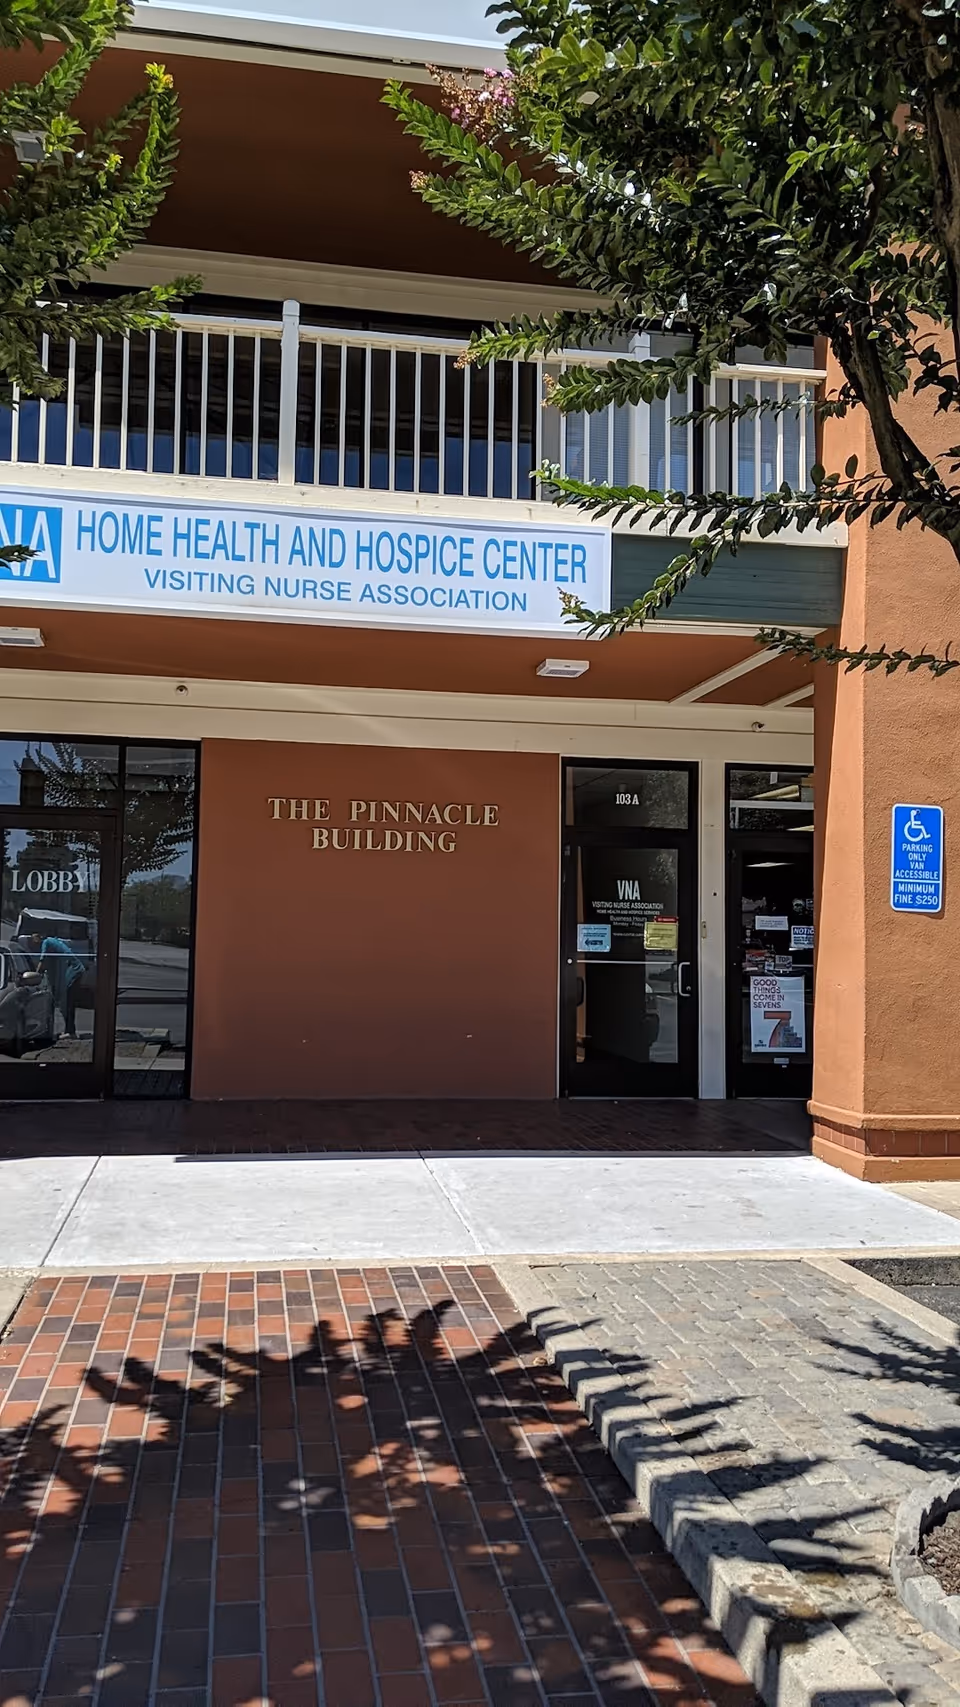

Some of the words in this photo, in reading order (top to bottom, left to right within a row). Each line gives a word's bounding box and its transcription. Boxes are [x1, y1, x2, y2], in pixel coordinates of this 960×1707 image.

[77, 510, 163, 556] HOME
[173, 517, 280, 564] HEALTH
[288, 525, 346, 569] AND
[355, 529, 475, 577] HOSPICE
[482, 538, 587, 583] CENTER
[144, 568, 255, 595] VISITING
[264, 576, 351, 601] NURSE
[359, 583, 527, 612] ASSOCIATION
[268, 798, 331, 821] THE
[349, 800, 500, 826] PINNACLE
[312, 827, 457, 853] BUILDING
[902, 843, 933, 853] PARKING
[908, 852, 926, 861] ONLY
[910, 861, 924, 870] VAN
[11, 870, 90, 893] LOBBY
[895, 870, 938, 880] ACCESSIBLE
[617, 880, 640, 900] VNA
[898, 883, 935, 894] MINIMUM
[894, 894, 913, 904] FINE
